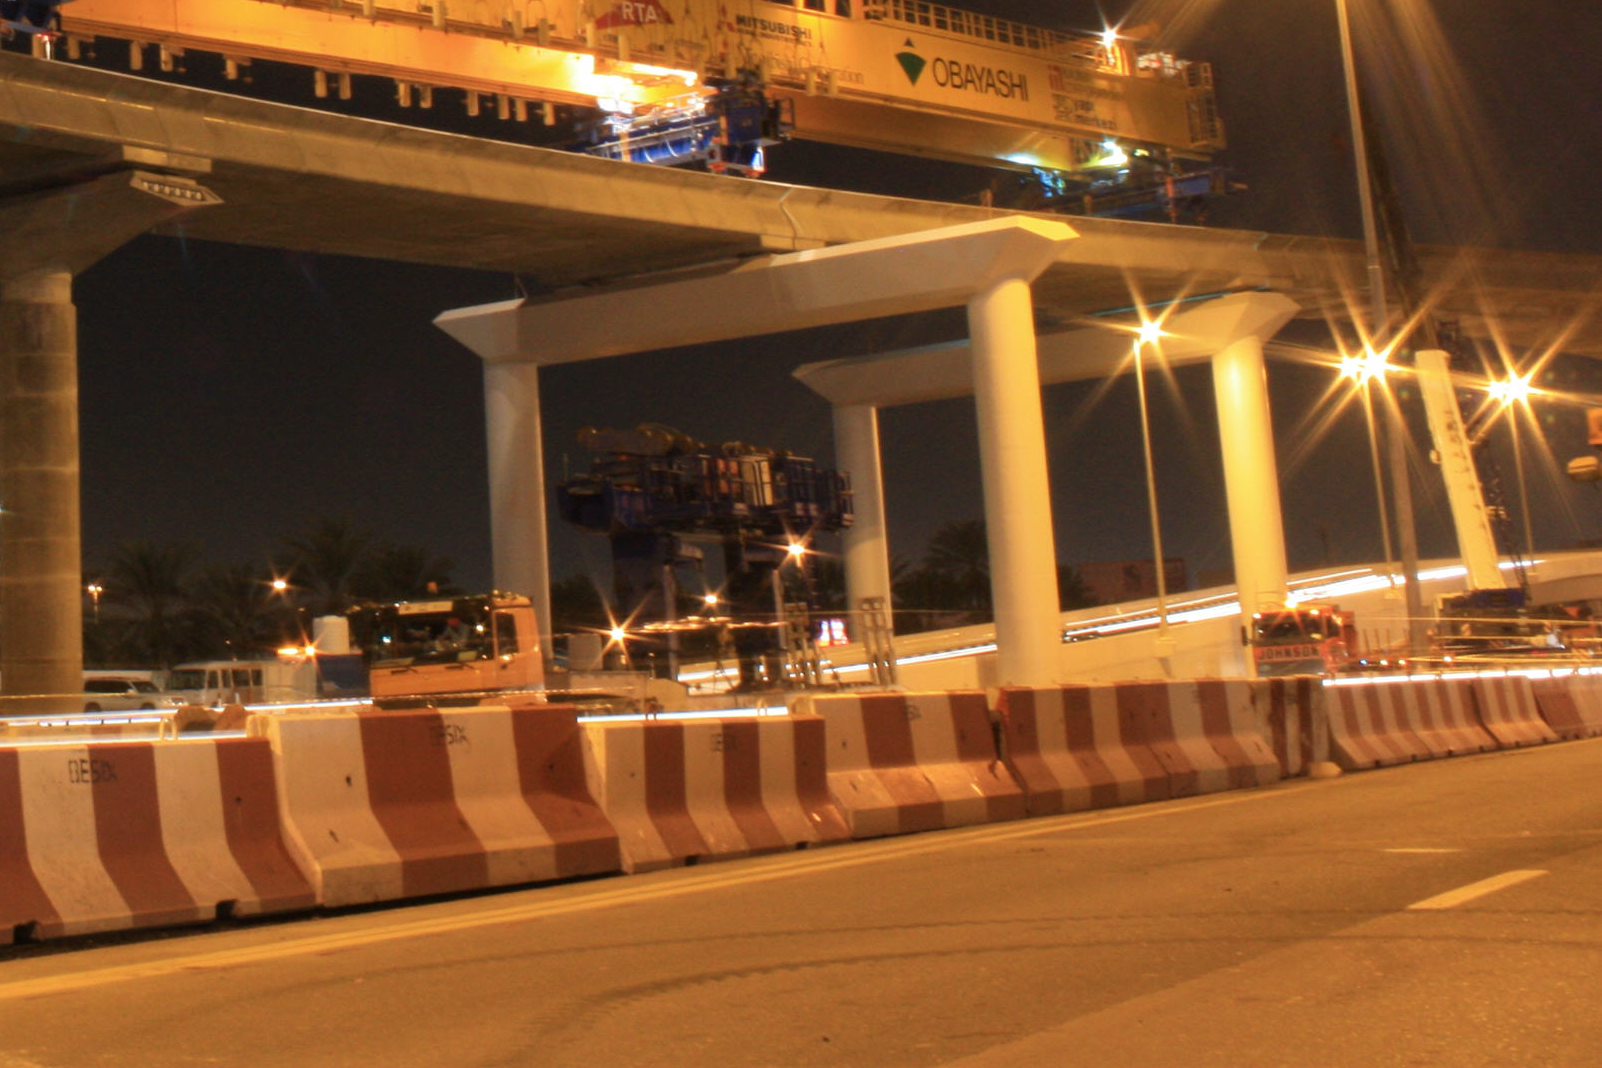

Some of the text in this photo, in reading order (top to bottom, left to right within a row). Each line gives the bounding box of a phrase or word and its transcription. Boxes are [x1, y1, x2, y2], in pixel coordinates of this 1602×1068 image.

[621, 0, 658, 23] RTA
[736, 15, 812, 40] MITSUBISHI
[932, 57, 1029, 102] OBAYASHI
